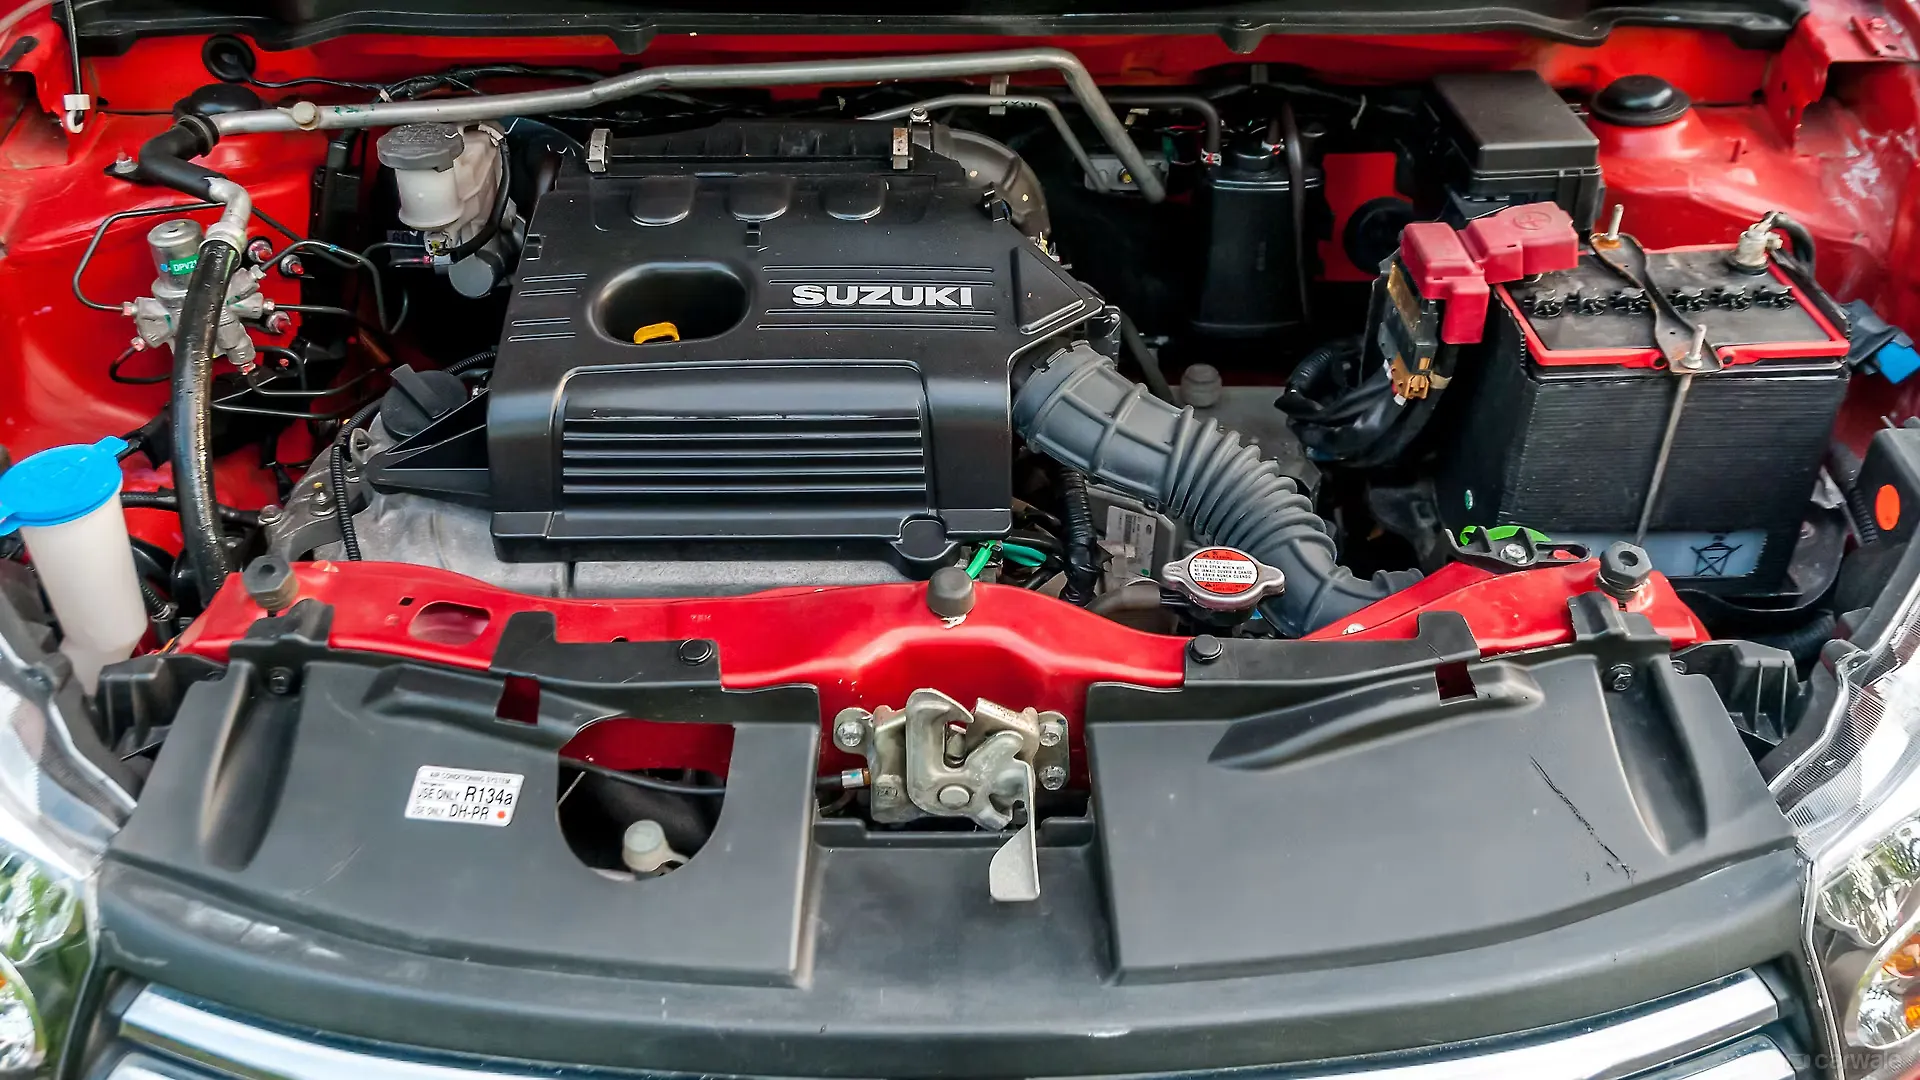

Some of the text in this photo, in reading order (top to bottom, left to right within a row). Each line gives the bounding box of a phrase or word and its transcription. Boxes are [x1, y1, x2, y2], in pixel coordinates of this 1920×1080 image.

[792, 285, 974, 308] SUZUKI
[418, 786, 513, 805] USE ONLY R134a
[449, 804, 489, 820] DH-PR
